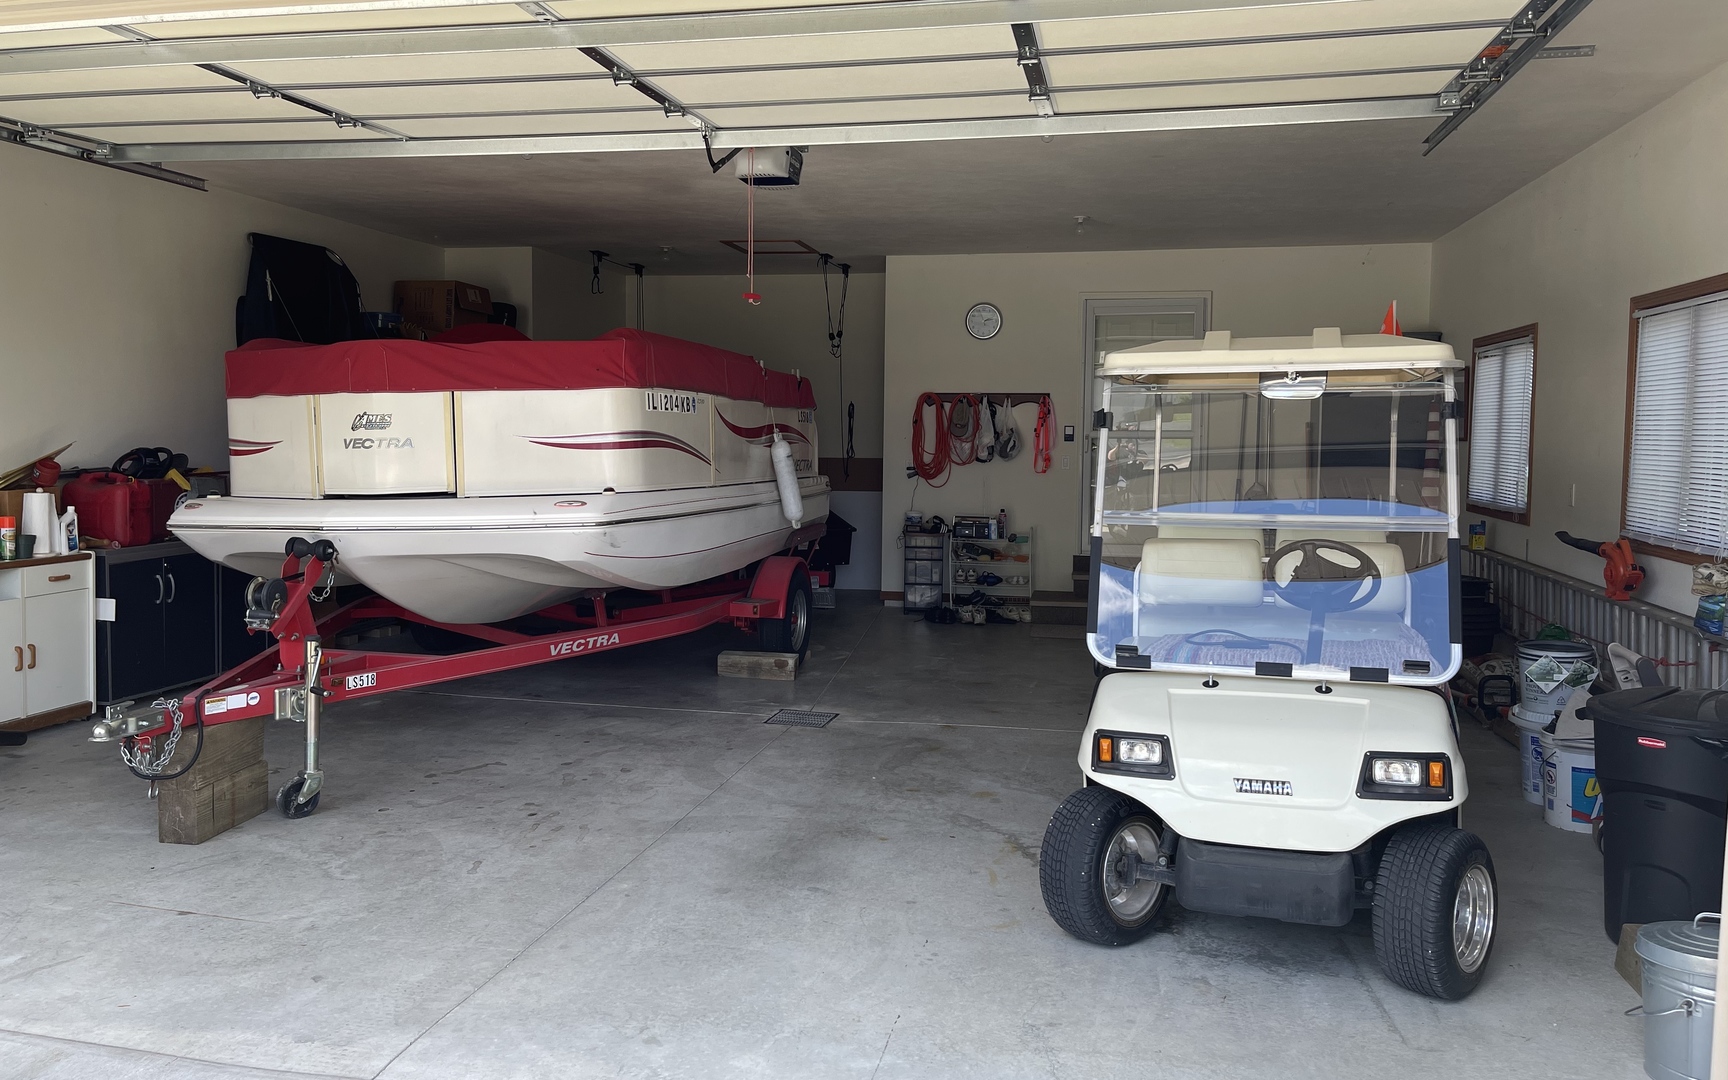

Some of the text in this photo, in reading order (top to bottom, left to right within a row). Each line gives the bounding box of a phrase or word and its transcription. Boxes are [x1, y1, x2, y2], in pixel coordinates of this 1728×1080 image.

[647, 392, 657, 410] IL
[660, 393, 680, 411] 1204
[343, 437, 415, 450] VECTRA
[549, 632, 620, 656] VECTRA
[346, 673, 376, 690] LS518
[1233, 778, 1293, 796] YAMAHA
